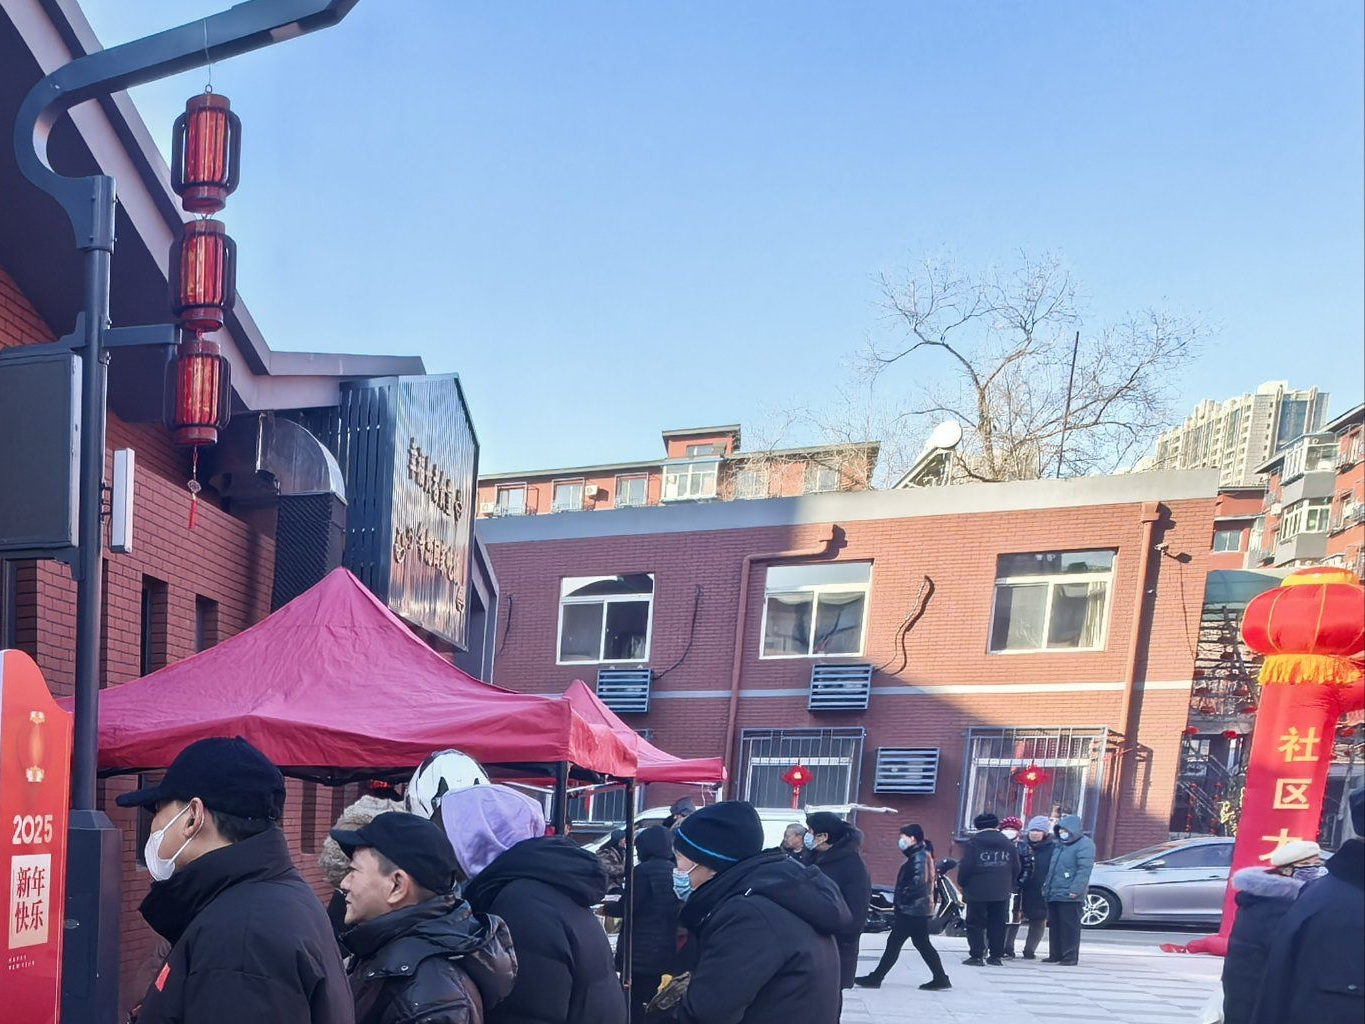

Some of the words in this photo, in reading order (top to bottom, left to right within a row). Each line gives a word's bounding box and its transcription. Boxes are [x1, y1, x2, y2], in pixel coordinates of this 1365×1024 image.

[12, 814, 53, 845] 2025
[16, 866, 46, 899] 新年
[14, 900, 44, 935] 快乐
